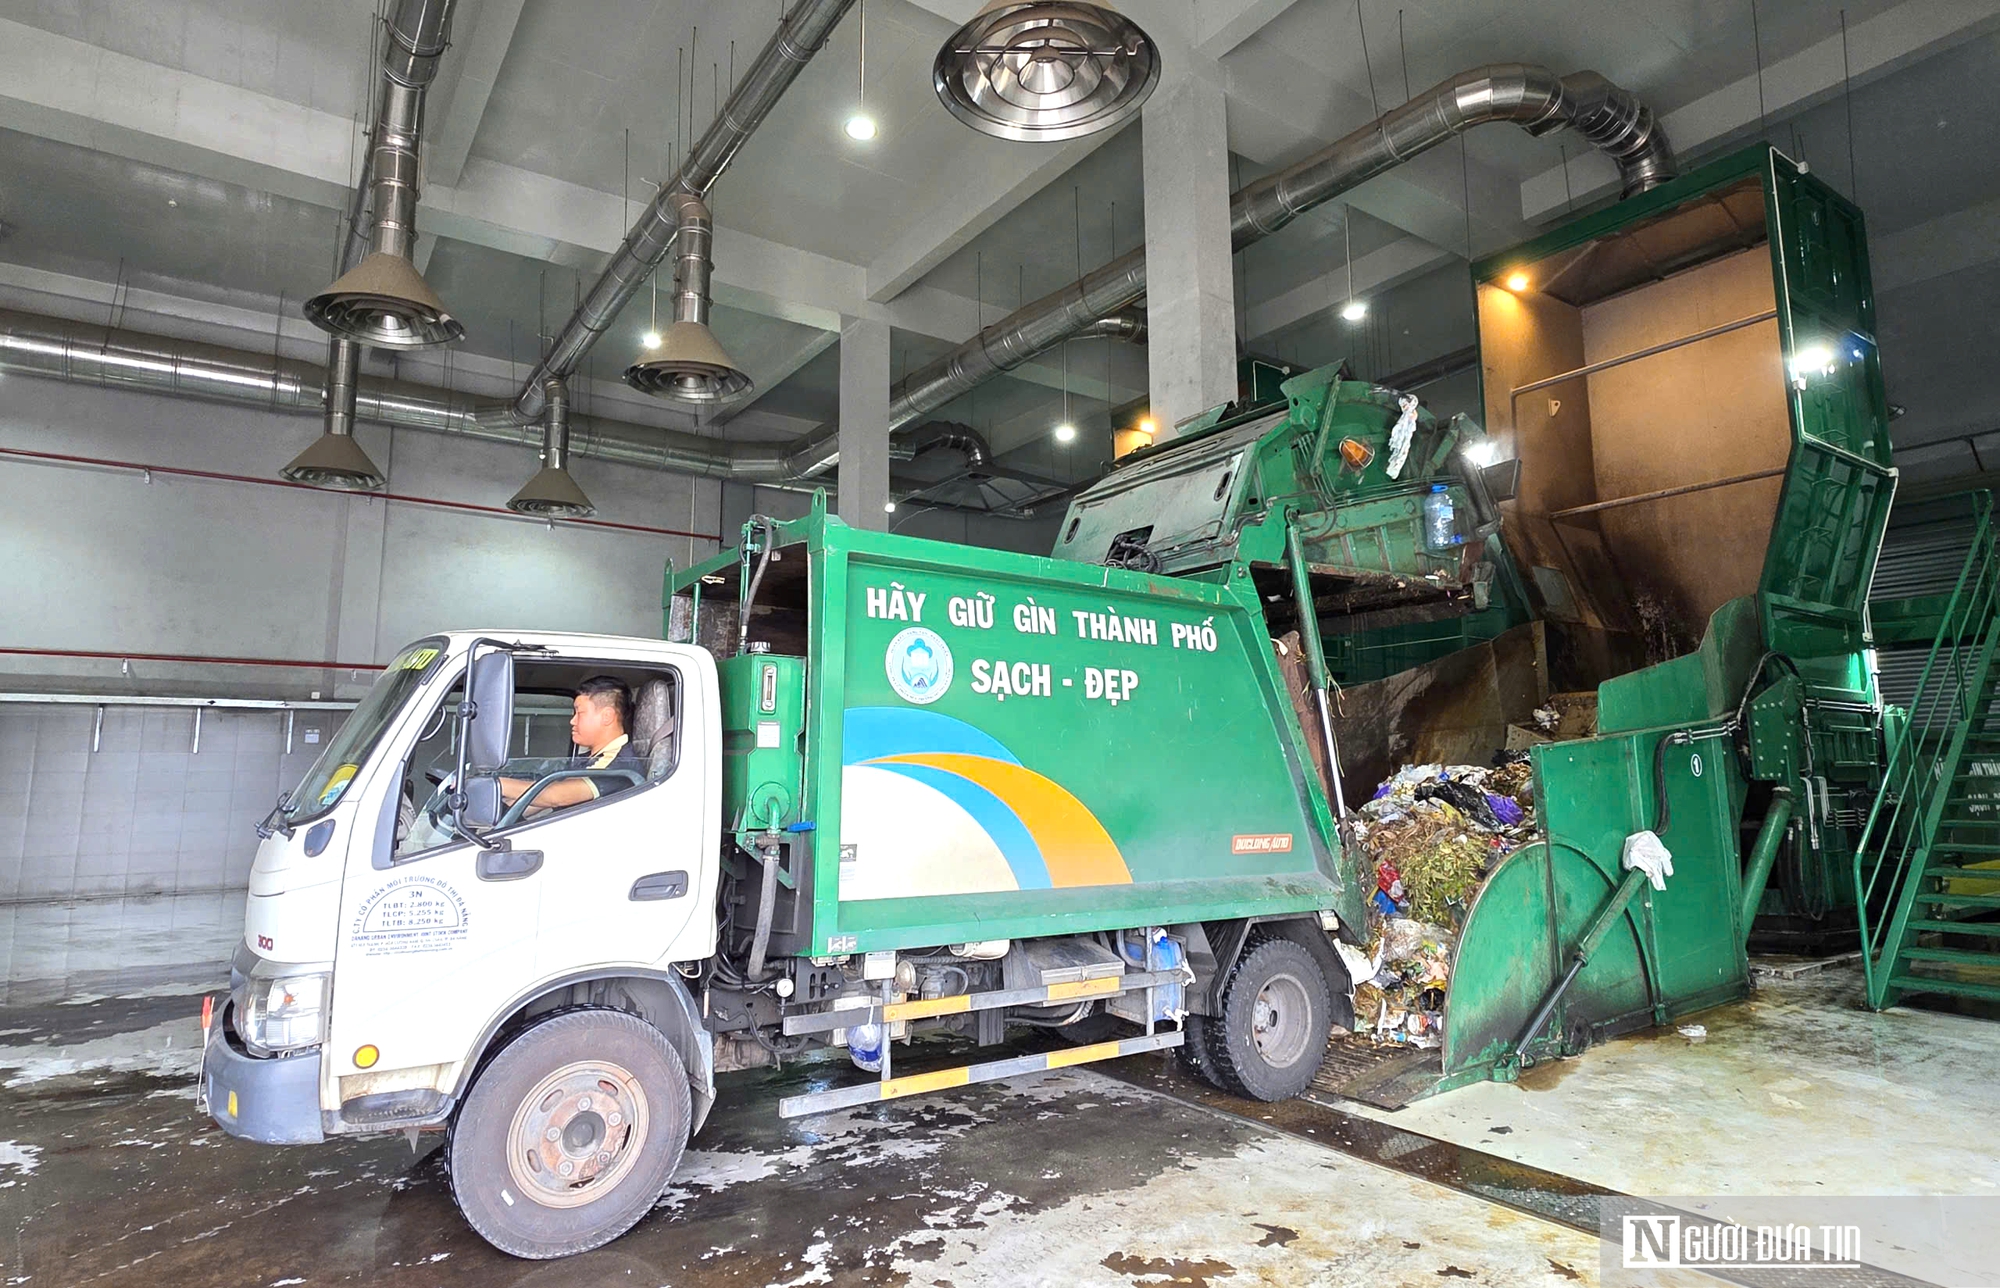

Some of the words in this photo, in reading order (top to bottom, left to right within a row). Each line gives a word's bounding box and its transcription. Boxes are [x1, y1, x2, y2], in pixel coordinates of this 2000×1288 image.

[866, 582, 926, 622] HÃY
[948, 591, 996, 629] GIỮ
[1013, 597, 1057, 635] GÌN
[1072, 606, 1158, 645] THÀNH
[1171, 616, 1218, 652] PHỐ
[970, 659, 1052, 701] SẠCH
[1084, 667, 1139, 706] ĐẸP
[1235, 838, 1270, 850] DUCLONG
